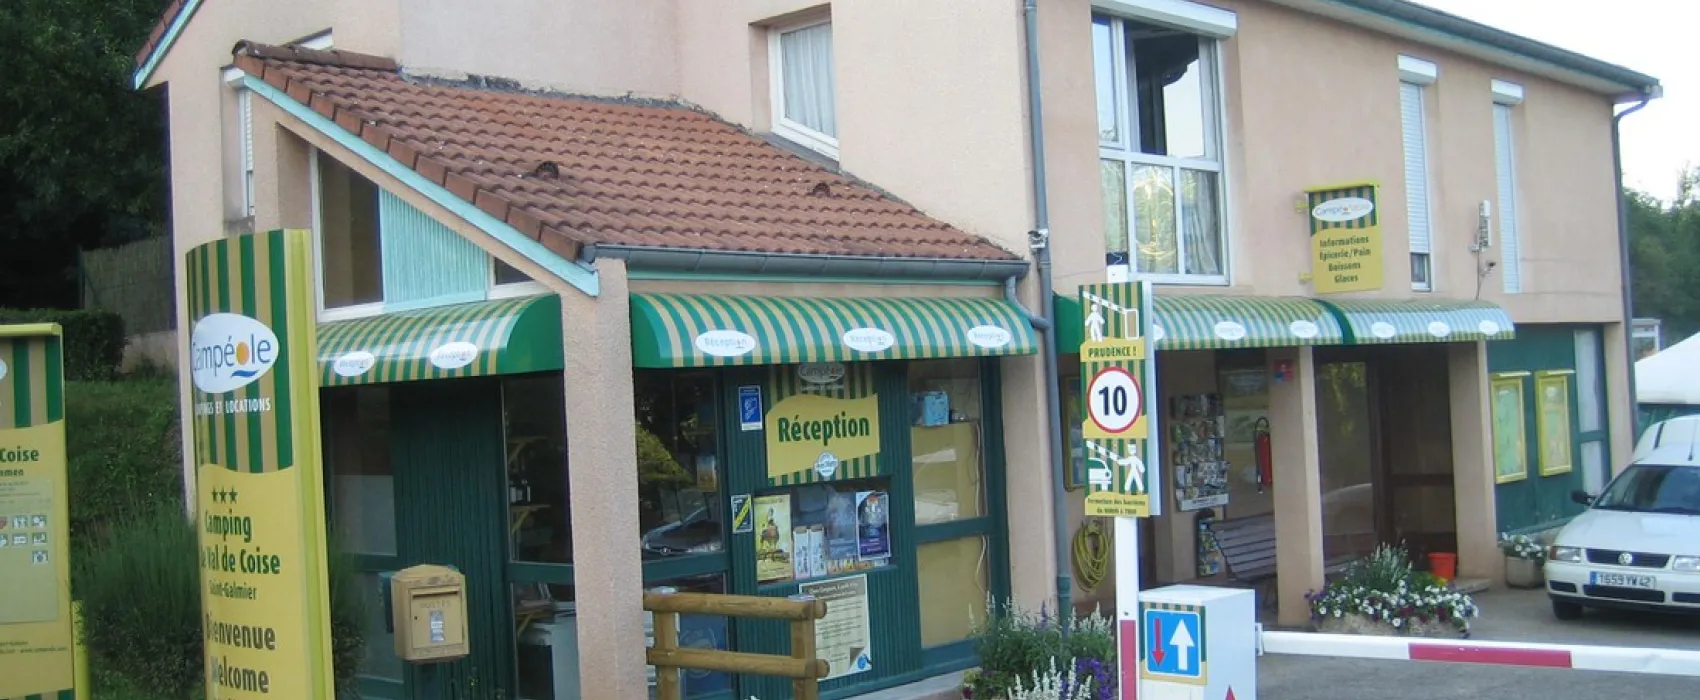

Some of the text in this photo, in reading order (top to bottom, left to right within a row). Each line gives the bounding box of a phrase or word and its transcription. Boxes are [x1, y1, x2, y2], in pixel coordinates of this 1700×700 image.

[1320, 235, 1369, 247] Informations
[1329, 262, 1361, 272] Boissons
[1334, 274, 1359, 283] Glaces
[1088, 346, 1130, 358] PRUDENCE
[225, 397, 272, 413] LOCATIONS
[1098, 385, 1127, 416] 10
[778, 411, 870, 446] Réception
[205, 508, 252, 543] Camping
[222, 544, 236, 573] de
[240, 547, 280, 574] Coise
[206, 609, 276, 650] Bienvenue
